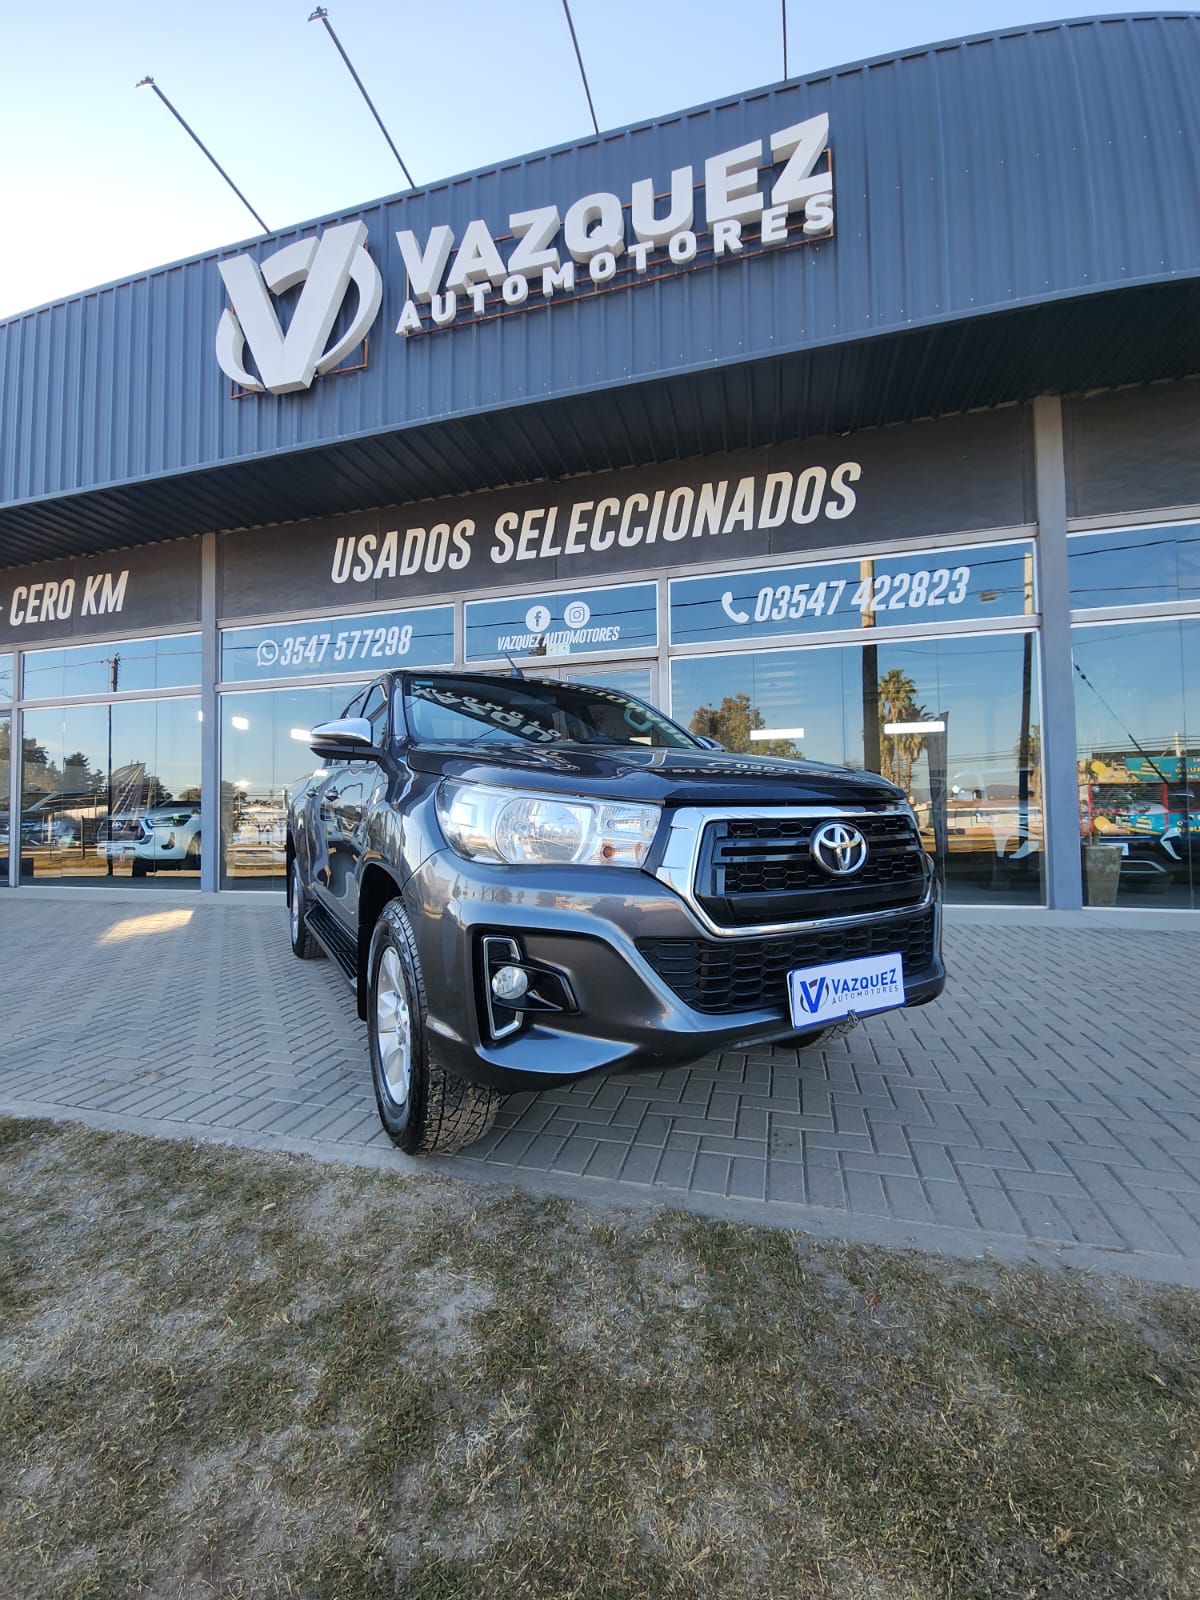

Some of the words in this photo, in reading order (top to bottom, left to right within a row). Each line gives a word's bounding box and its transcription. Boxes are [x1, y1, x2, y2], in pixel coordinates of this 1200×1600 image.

[396, 112, 832, 302] VAZQUEZ
[395, 192, 834, 336] AUTOMOTORES
[331, 519, 475, 584] USADOS
[490, 462, 862, 564] SELECCIONADOS
[9, 578, 76, 626] CERO
[81, 570, 129, 616] KM
[754, 580, 846, 622] 03547
[851, 567, 970, 613] 422823
[280, 634, 331, 666] 3547
[334, 625, 413, 661] 577298
[497, 633, 542, 651] VAZQUEZ
[543, 626, 621, 647] AUTOMOTORES
[831, 968, 897, 996] VAZQUEZ
[832, 985, 899, 1005] AUTOMOTORES
